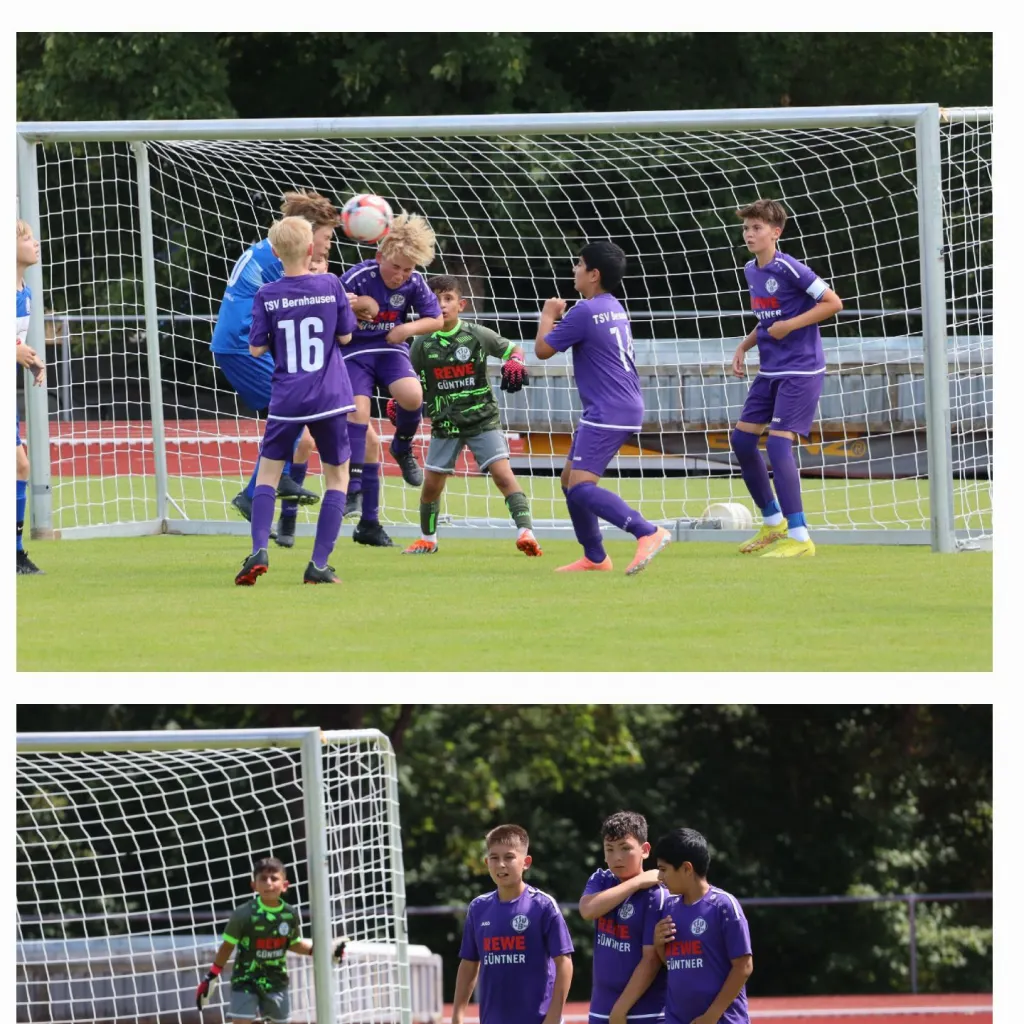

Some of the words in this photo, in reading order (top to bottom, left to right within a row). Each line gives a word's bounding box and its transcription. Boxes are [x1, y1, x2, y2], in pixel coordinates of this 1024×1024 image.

[282, 294, 337, 308] Bernhausen
[592, 311, 610, 325] TSV
[278, 316, 325, 374] 16
[433, 362, 476, 380] REWE
[437, 376, 476, 390] GÜNTNER
[483, 935, 526, 952] REWE
[483, 952, 526, 966] GÜNTNER
[666, 957, 704, 971] GÜNTNER
